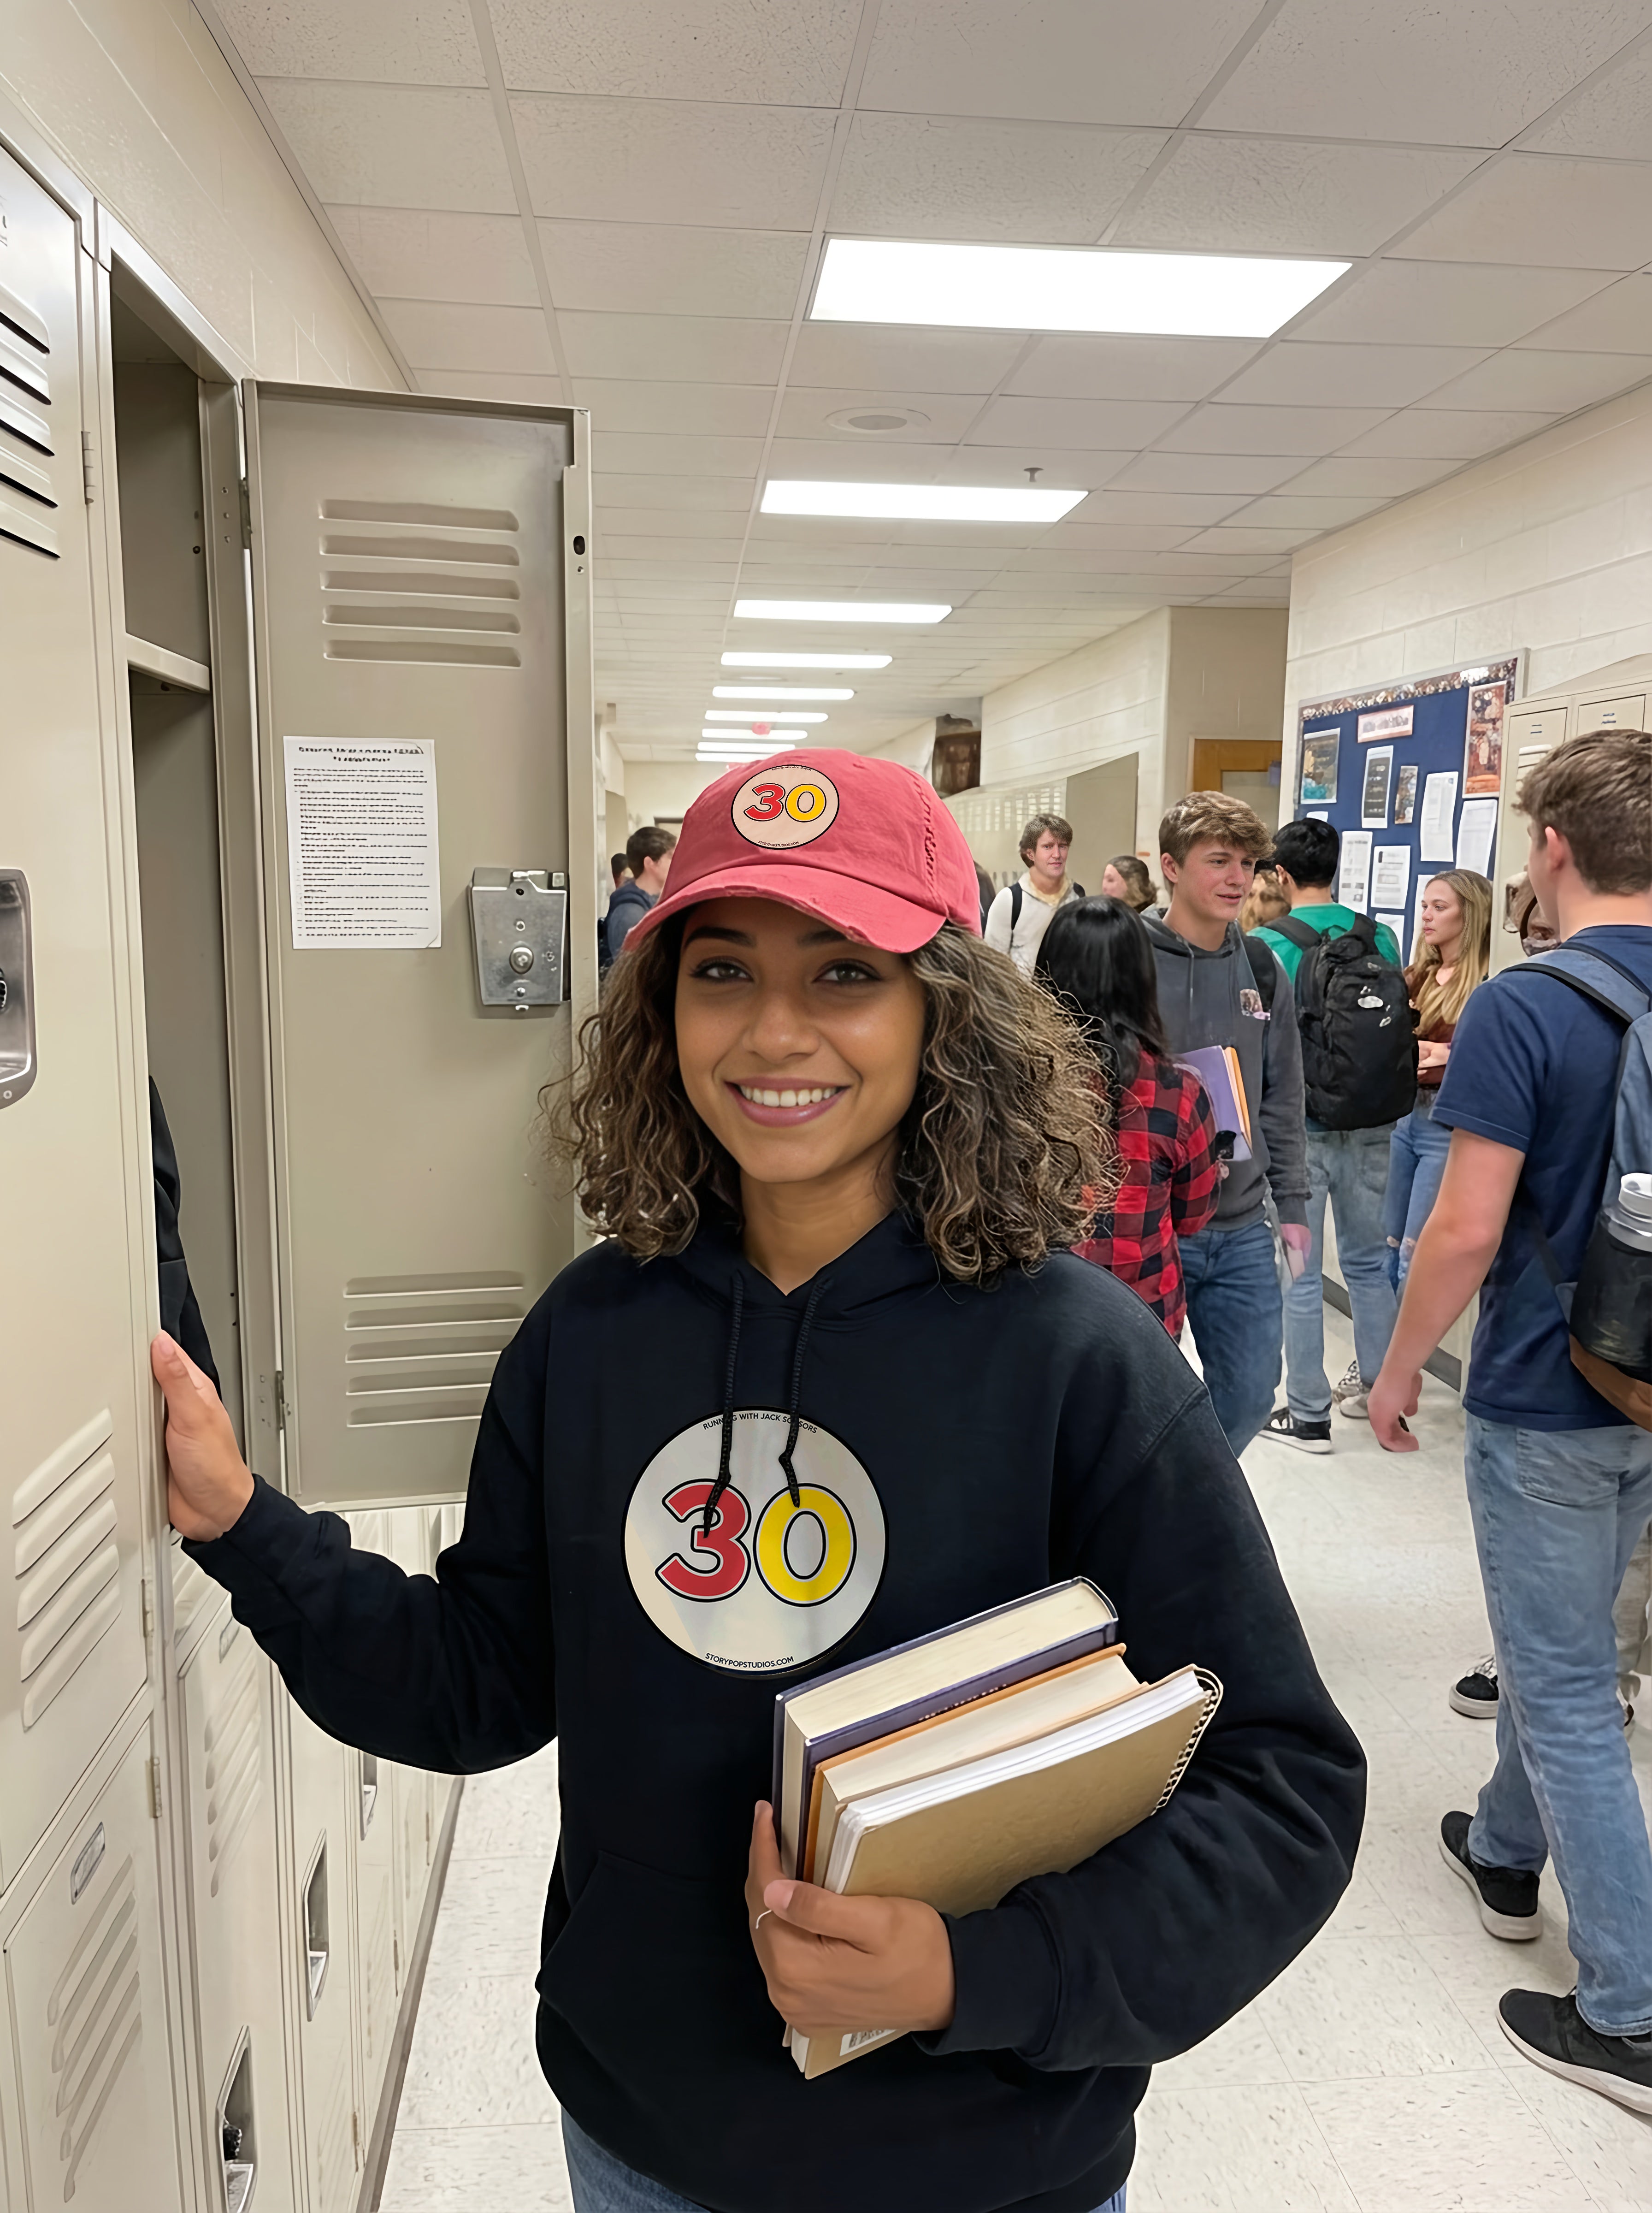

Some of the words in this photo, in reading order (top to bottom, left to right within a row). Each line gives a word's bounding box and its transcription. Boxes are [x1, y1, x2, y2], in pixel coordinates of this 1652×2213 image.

[743, 783, 826, 822] 30
[702, 1414, 738, 1430] RUNNG
[761, 1413, 781, 1421] JACK
[782, 1416, 818, 1434] SCSORS
[655, 1478, 857, 1608] 30
[705, 1653, 794, 1668] STORYPOPSTUDIOS.COM
